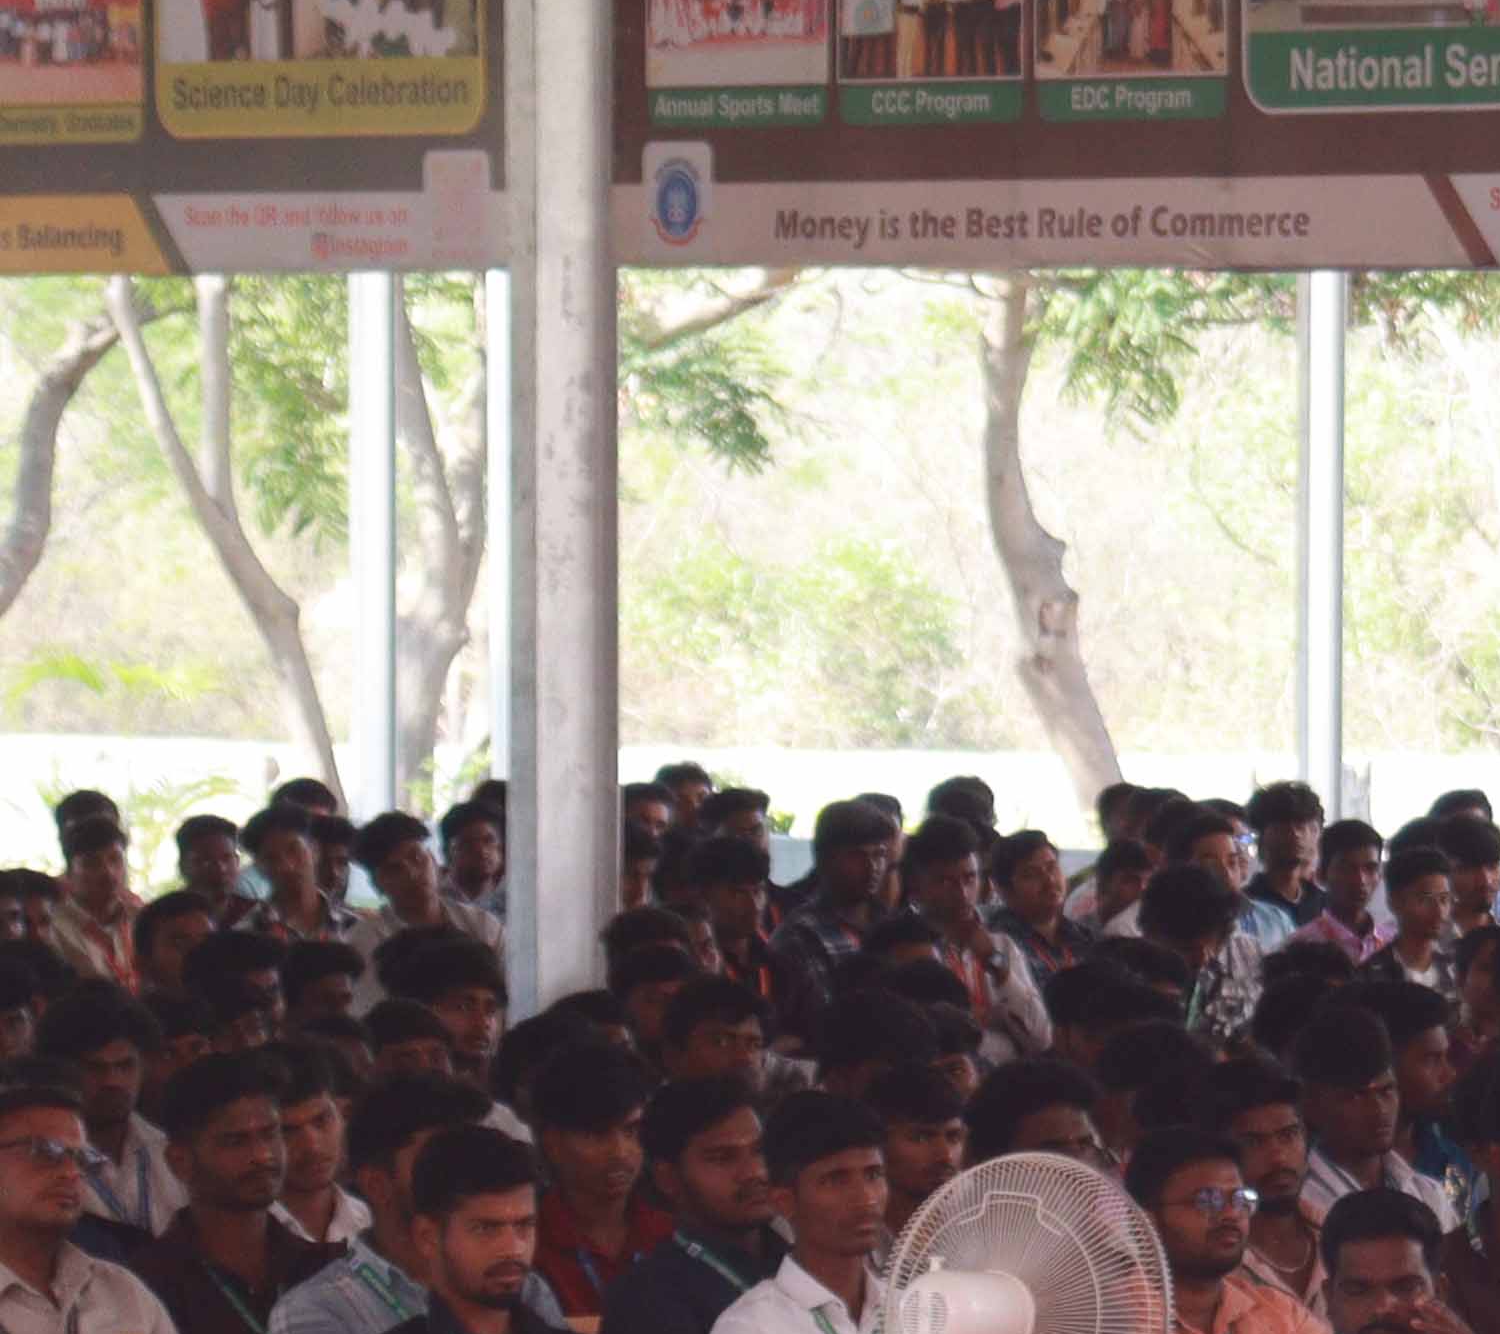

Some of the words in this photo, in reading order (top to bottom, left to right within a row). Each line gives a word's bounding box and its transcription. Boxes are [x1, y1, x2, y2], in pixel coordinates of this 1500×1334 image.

[1289, 46, 1434, 91] National
[173, 80, 266, 111] Science
[273, 78, 320, 111] Day
[327, 75, 468, 107] Celebration
[655, 92, 714, 116] Annual
[718, 91, 773, 119] Sports
[778, 90, 819, 115] Meet
[871, 91, 912, 113] CCC
[915, 91, 991, 117] Program
[1071, 85, 1110, 110] EDC
[1114, 85, 1192, 115] Program
[774, 209, 870, 246] Money
[878, 210, 900, 240] is
[909, 207, 956, 239] the
[964, 207, 1029, 240] Best
[1036, 205, 1104, 238] Rule
[1110, 204, 1142, 237] of
[1150, 203, 1310, 239] Commerce
